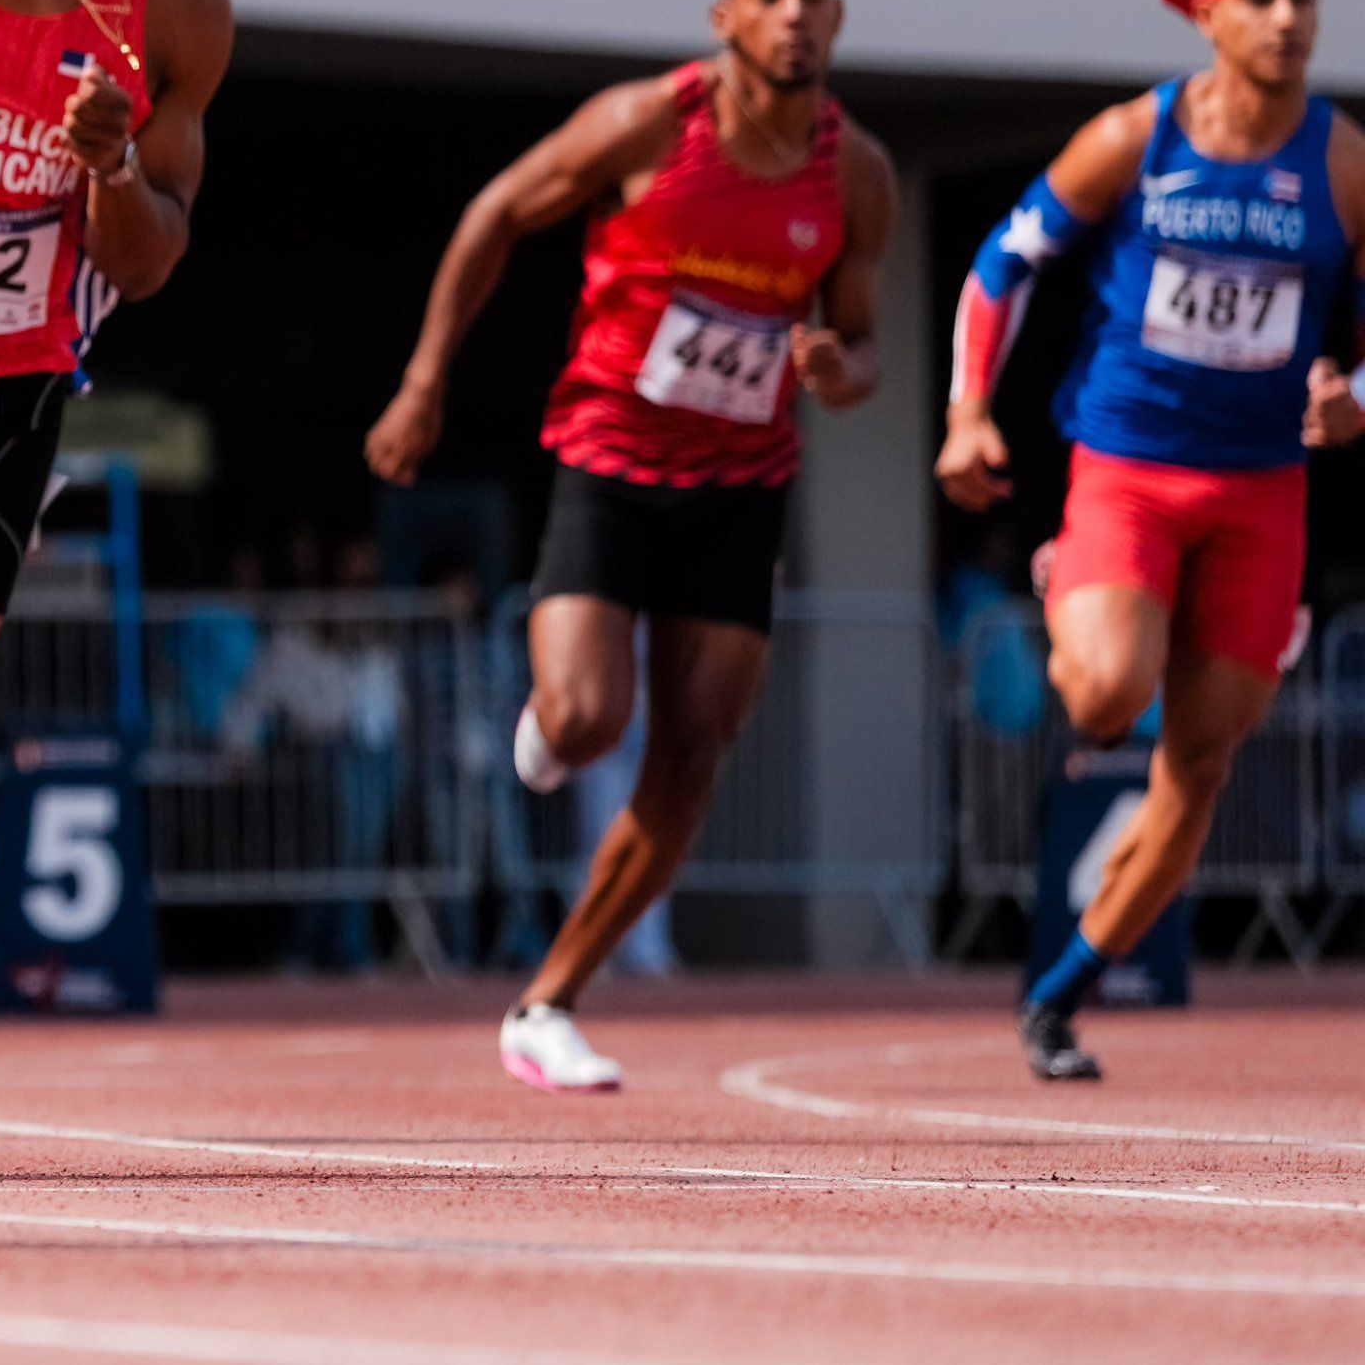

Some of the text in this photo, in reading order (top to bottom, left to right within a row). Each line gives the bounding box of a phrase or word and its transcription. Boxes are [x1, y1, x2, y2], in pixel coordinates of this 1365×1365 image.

[1141, 195, 1306, 251] PUERTO RICO
[1171, 278, 1278, 334] 487
[20, 785, 124, 943] 5
